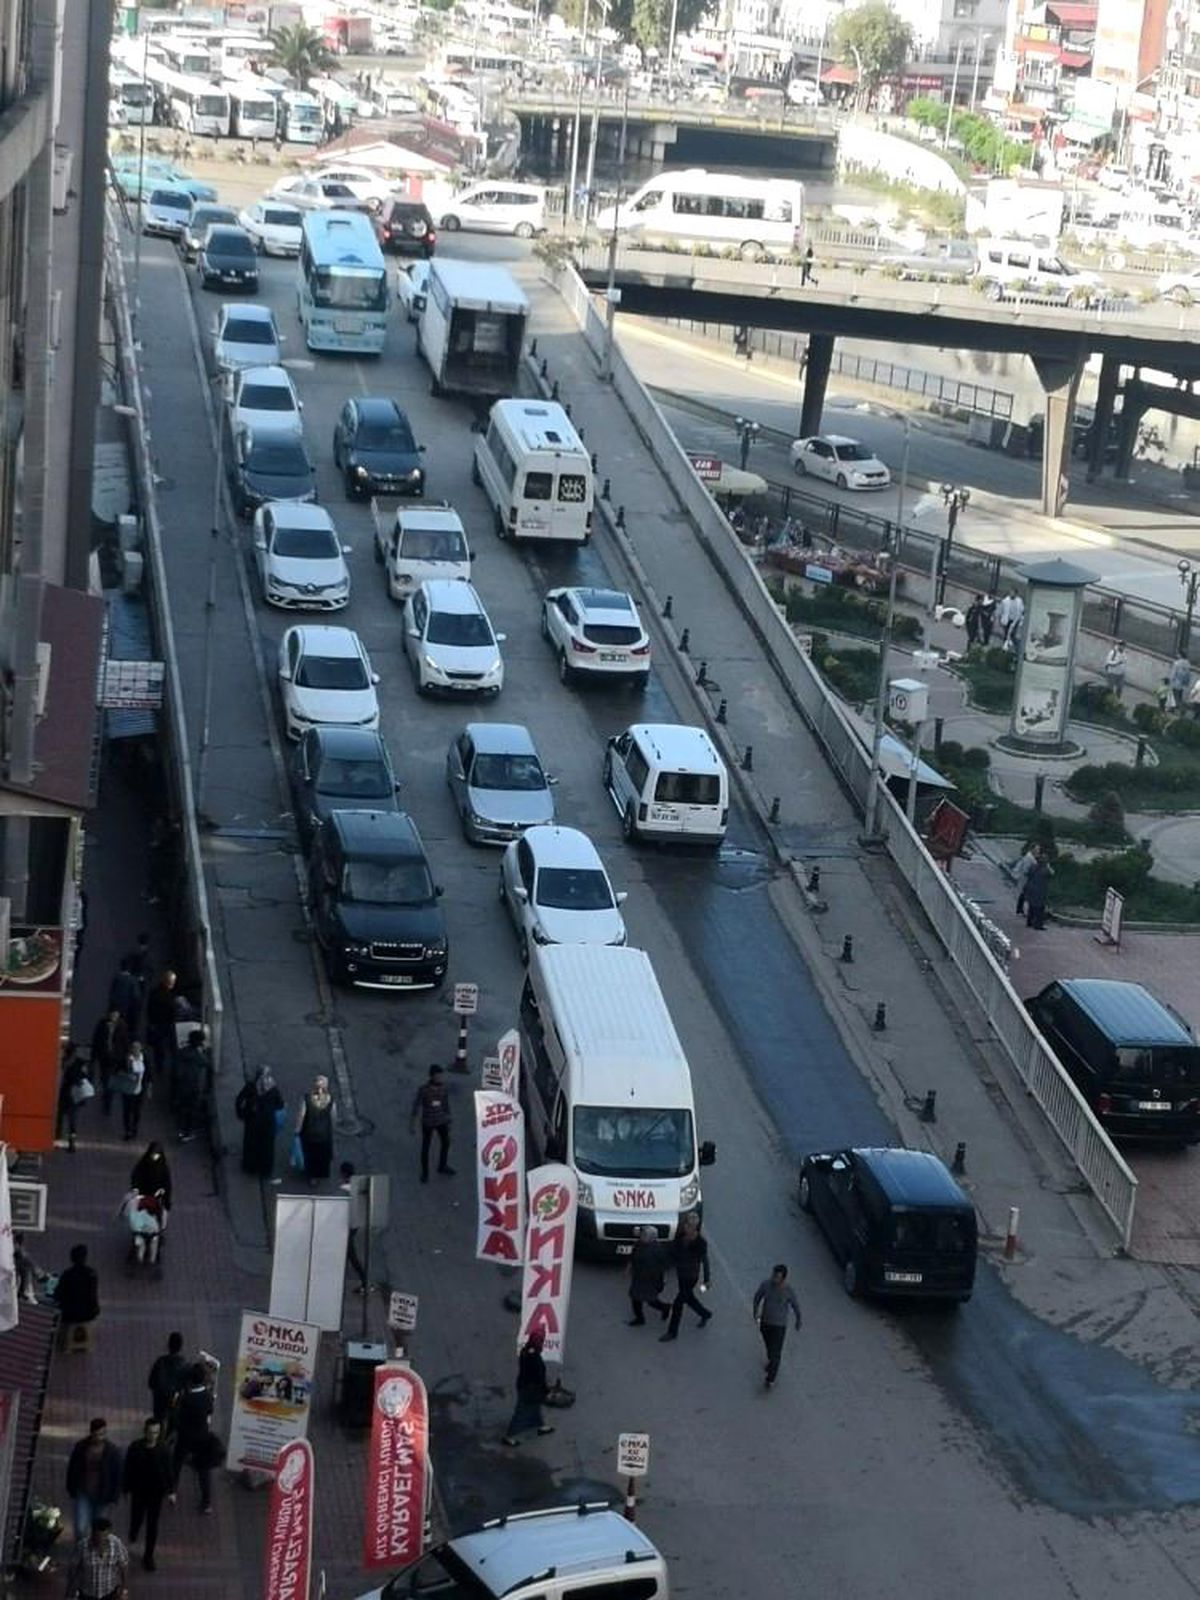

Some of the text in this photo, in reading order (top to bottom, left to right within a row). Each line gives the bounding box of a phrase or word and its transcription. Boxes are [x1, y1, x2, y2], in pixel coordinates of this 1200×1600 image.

[613, 1189, 656, 1209] ONKA
[253, 1320, 306, 1344] ONKA
[247, 1335, 266, 1347] KIZ
[268, 1340, 309, 1355] YURDU
